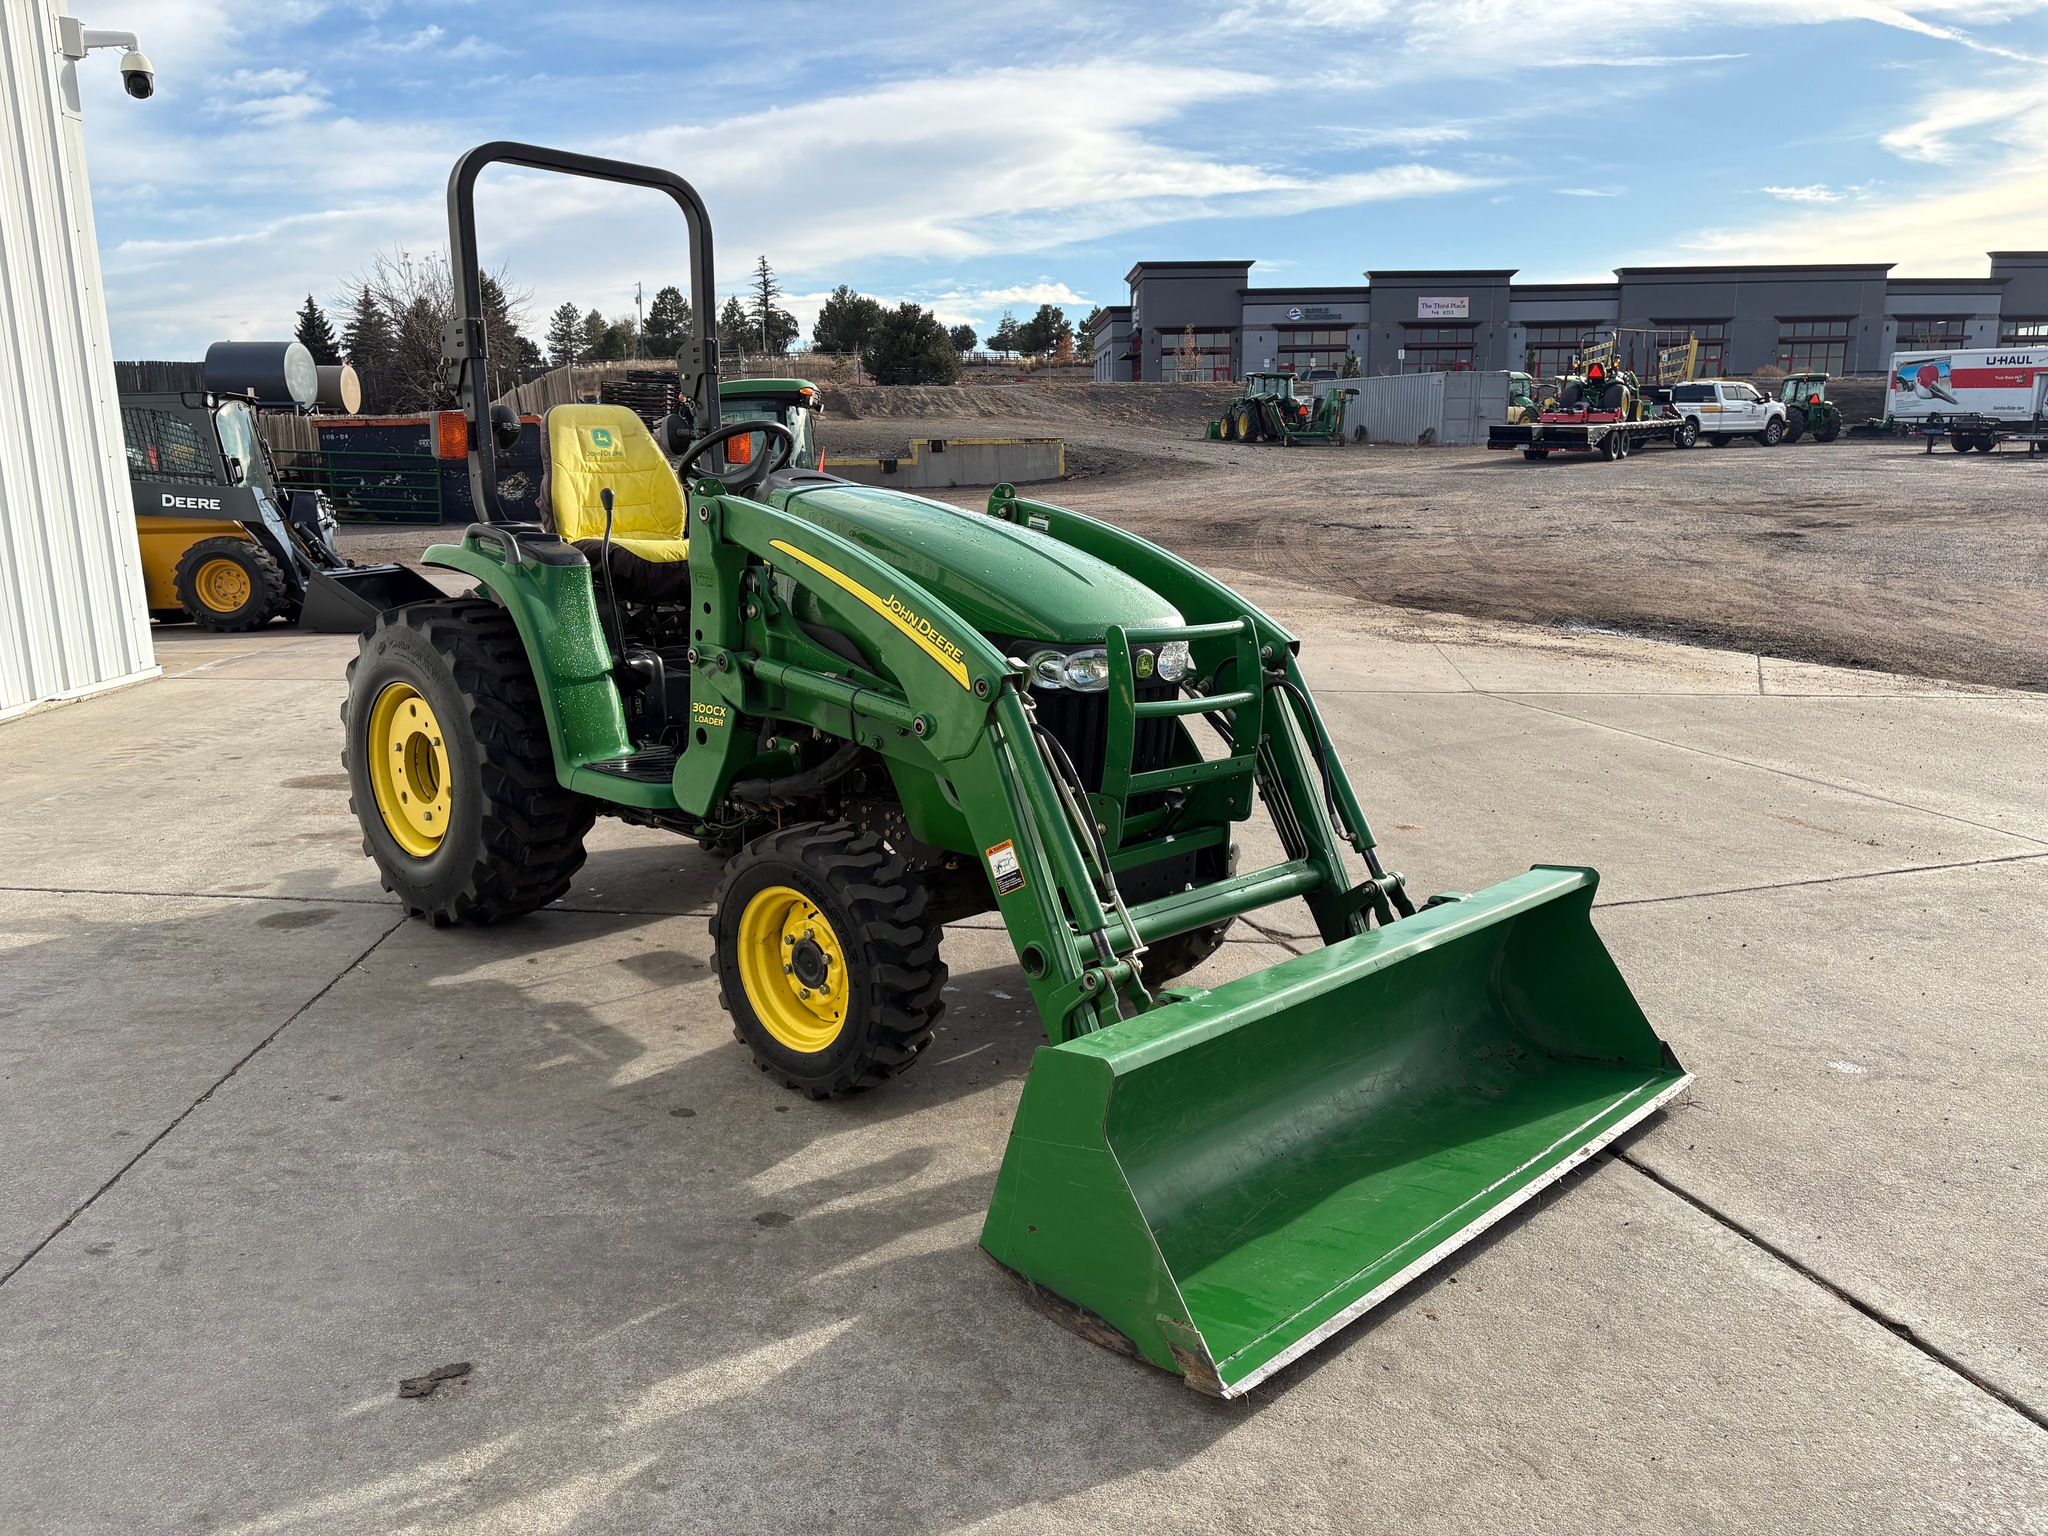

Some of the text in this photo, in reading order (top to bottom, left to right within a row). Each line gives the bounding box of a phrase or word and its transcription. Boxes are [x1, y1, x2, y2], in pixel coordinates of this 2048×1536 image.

[1986, 355, 2032, 365] U-HAUL
[161, 493, 221, 510] DEERE
[882, 594, 964, 662] JOHN DEERE
[692, 703, 727, 717] 300CX
[694, 715, 724, 727] LOADER
[993, 841, 1010, 852] WARNING
